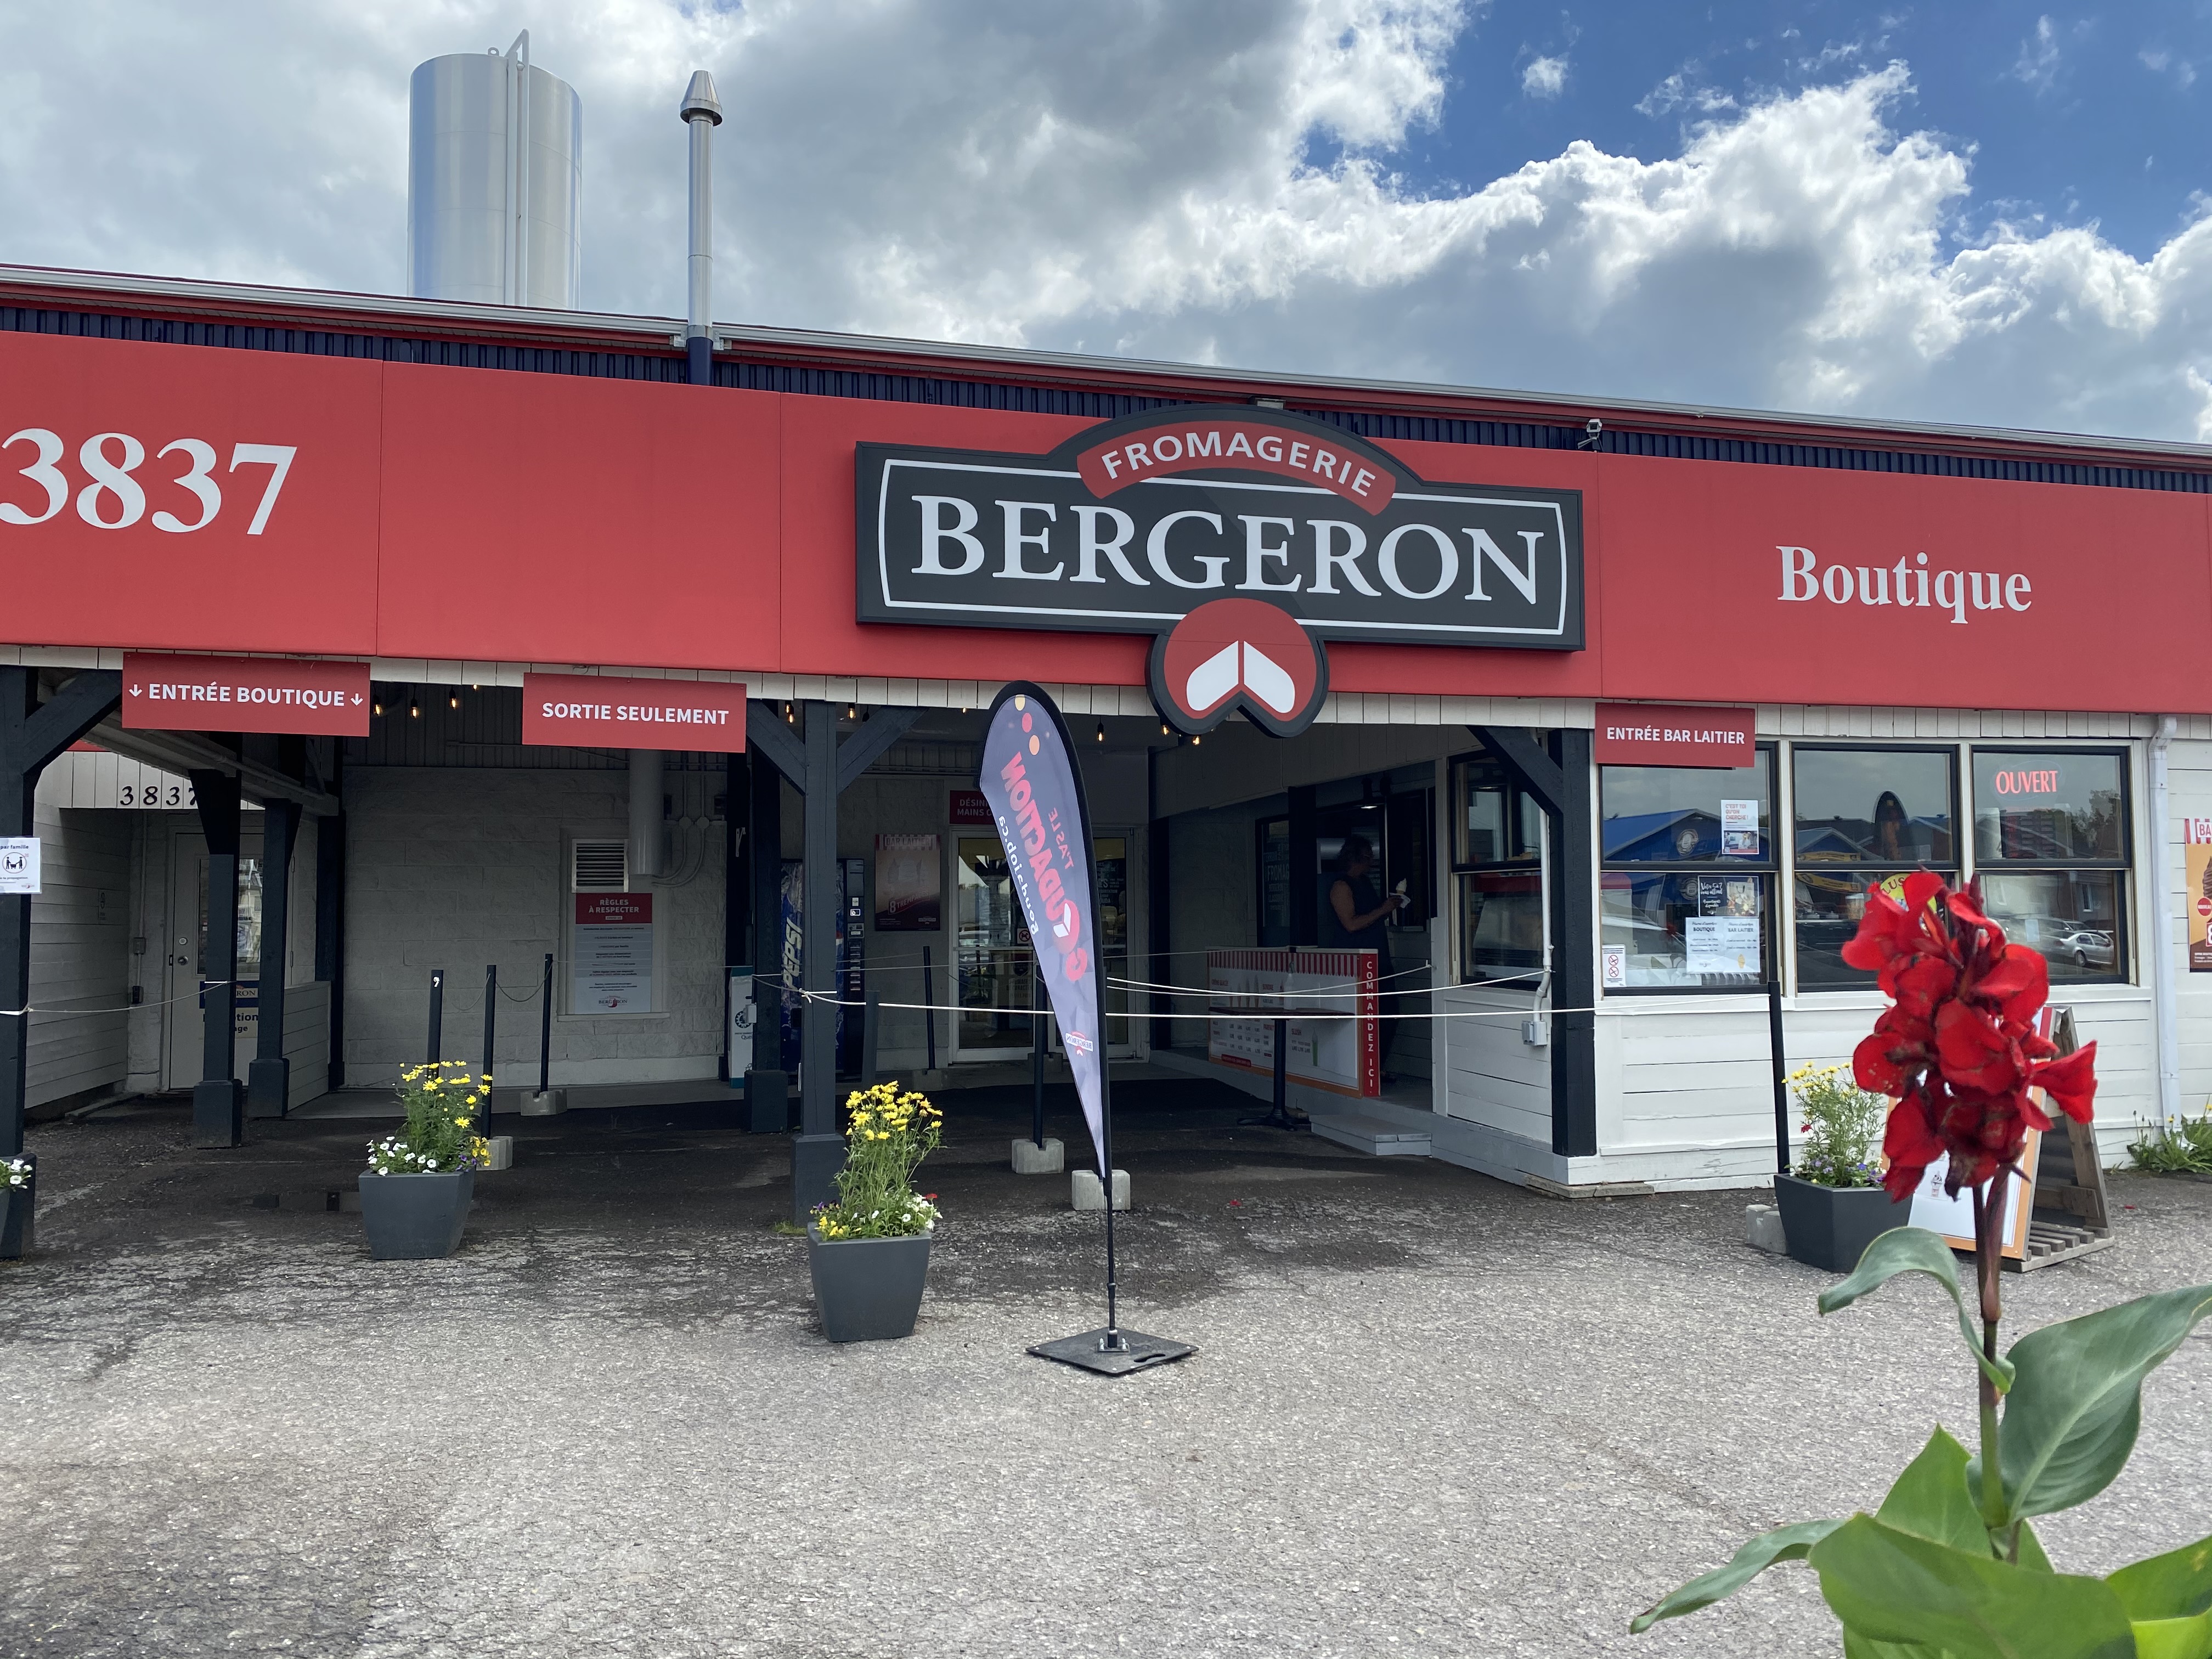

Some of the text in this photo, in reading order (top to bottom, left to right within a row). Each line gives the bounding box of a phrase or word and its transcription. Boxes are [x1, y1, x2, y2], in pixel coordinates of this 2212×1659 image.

[1099, 431, 1378, 498] FROMAGERIE
[0, 427, 297, 535] 3837
[910, 494, 1544, 605] BERGERON
[1775, 545, 2032, 624] Boutique
[148, 681, 345, 709] ENTRÉE BOUTIQUE
[542, 702, 730, 725] SORTIE SEULEMENT
[1606, 724, 1745, 745] ENTRÉE BAR LAITIER
[1995, 770, 2058, 794] OUVERT
[2199, 823, 2212, 836] BA
[600, 898, 629, 906] RÈGLES
[889, 901, 896, 913] 8
